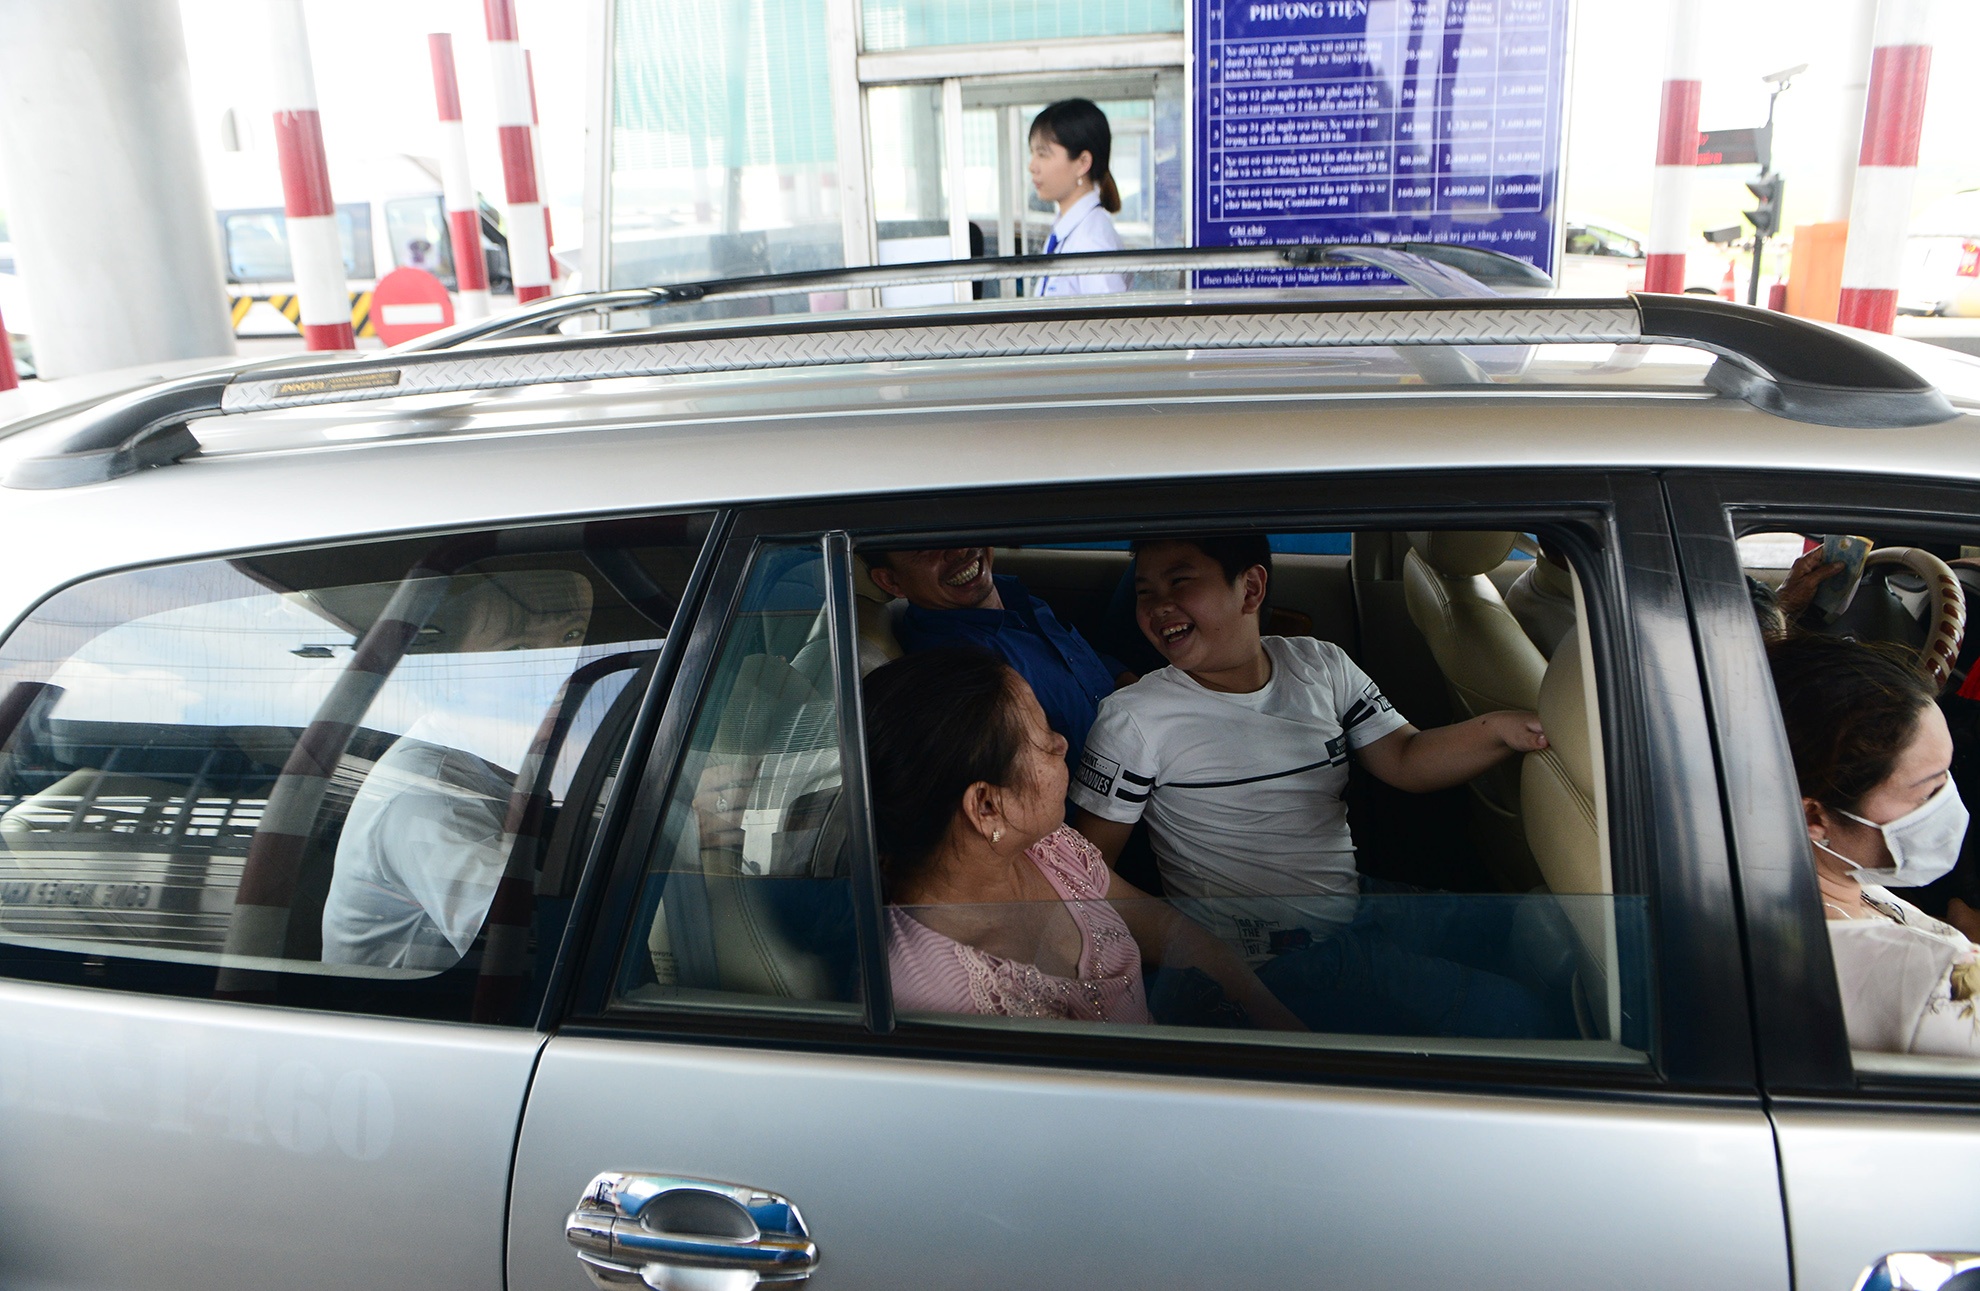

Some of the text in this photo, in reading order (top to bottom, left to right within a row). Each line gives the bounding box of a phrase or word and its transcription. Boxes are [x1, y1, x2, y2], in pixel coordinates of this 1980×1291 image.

[1250, 2, 1323, 21] PHƯƠNG
[1226, 45, 1237, 57] Xe
[1271, 41, 1287, 57] ghế
[1253, 55, 1268, 68] tấn
[1225, 66, 1294, 81] khách công cộng
[1226, 90, 1238, 102] Xe
[1238, 90, 1249, 102] từ
[1261, 86, 1277, 103] ghế
[1277, 85, 1297, 101] ngồi
[1297, 85, 1314, 99] đến
[1326, 83, 1342, 101] ghế
[1366, 84, 1378, 97] Xe
[1261, 103, 1285, 115] trọng
[1303, 99, 1319, 111] tấn
[1319, 98, 1335, 111] đến
[1336, 98, 1357, 110] dưới
[1365, 97, 1379, 109] tấn
[1226, 122, 1237, 134] Xe
[1238, 121, 1249, 134] từ
[1260, 118, 1277, 135] ghế
[1277, 118, 1296, 133] ngồi
[1329, 118, 1341, 130] Xe
[1225, 136, 1248, 149] trọng
[1249, 134, 1259, 146] từ
[1267, 132, 1282, 145] tấn
[1282, 131, 1298, 144] đến
[1298, 131, 1319, 143] dưới
[1332, 130, 1347, 142] tấn
[1226, 155, 1237, 168] Xe
[1238, 154, 1250, 167] tải
[1251, 154, 1262, 166] có
[1262, 153, 1274, 166] tải
[1274, 155, 1298, 167] trọng
[1298, 152, 1309, 164] từ
[1321, 150, 1336, 163] tấn
[1336, 149, 1353, 163] đến
[1353, 150, 1374, 162] dưới
[1225, 166, 1239, 178] tấn
[1240, 166, 1251, 178] và
[1279, 164, 1301, 177] hàng
[1301, 163, 1323, 176] bằng
[1323, 163, 1366, 175] Container
[1225, 187, 1237, 199] Xe
[1238, 186, 1250, 198] tải
[1250, 186, 1261, 198] có
[1261, 185, 1274, 198] tải
[1274, 187, 1298, 198] trọng
[1298, 184, 1308, 196] từ
[1320, 182, 1335, 195] tấn
[1350, 182, 1364, 194] lên
[1364, 181, 1376, 194] và
[1241, 198, 1263, 211] hàng
[1263, 197, 1285, 210] bằng
[1285, 197, 1327, 209] Container
[1229, 224, 1246, 237] Ghi
[1461, 231, 1476, 244] gia
[1501, 229, 1512, 243] áp
[1203, 274, 1222, 285] theo
[1223, 272, 1243, 284] thiết
[1244, 271, 1255, 284] kế
[1256, 274, 1283, 286] (trọng
[1285, 272, 1297, 283] tải
[1298, 271, 1319, 284] hàng
[1242, 927, 1261, 938] THE
